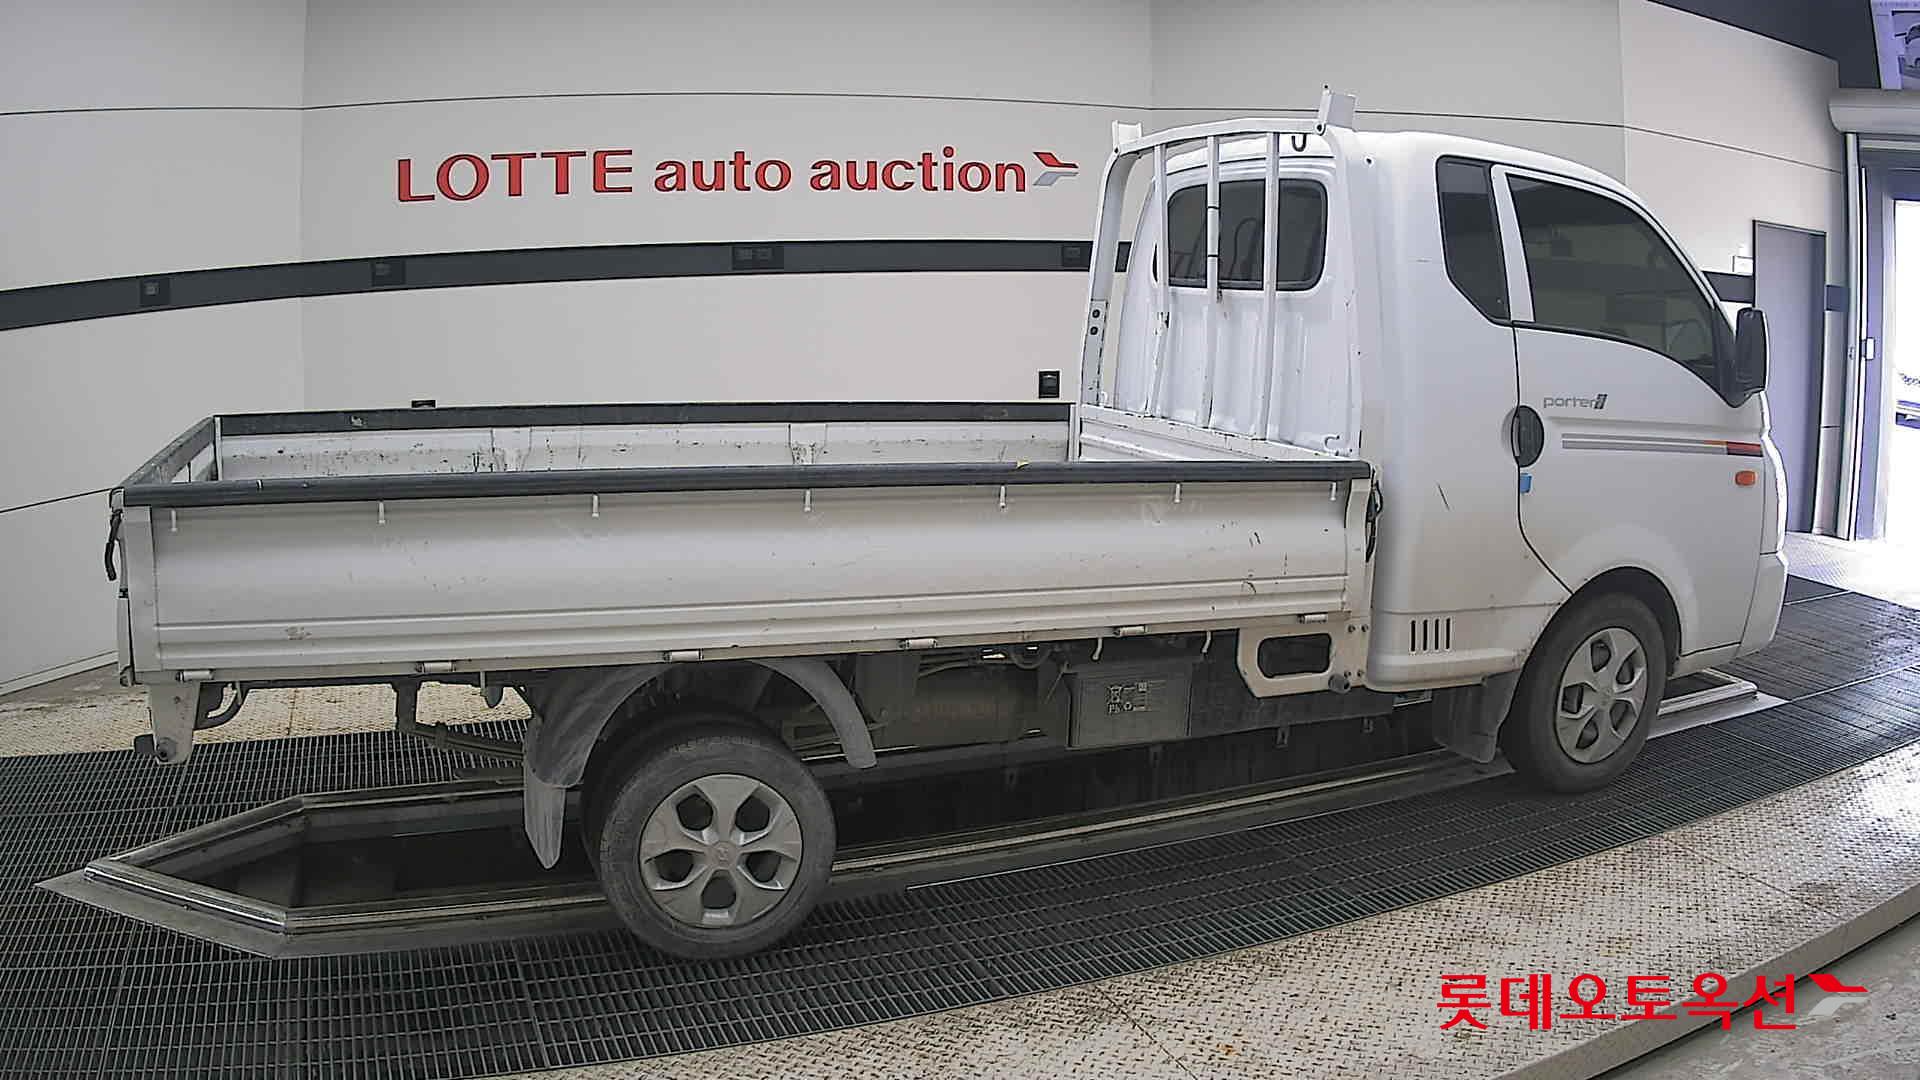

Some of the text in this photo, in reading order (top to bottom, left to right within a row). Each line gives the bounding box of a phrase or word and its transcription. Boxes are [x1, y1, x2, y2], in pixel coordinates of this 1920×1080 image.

[398, 146, 1026, 202] LOTTE auto auction
